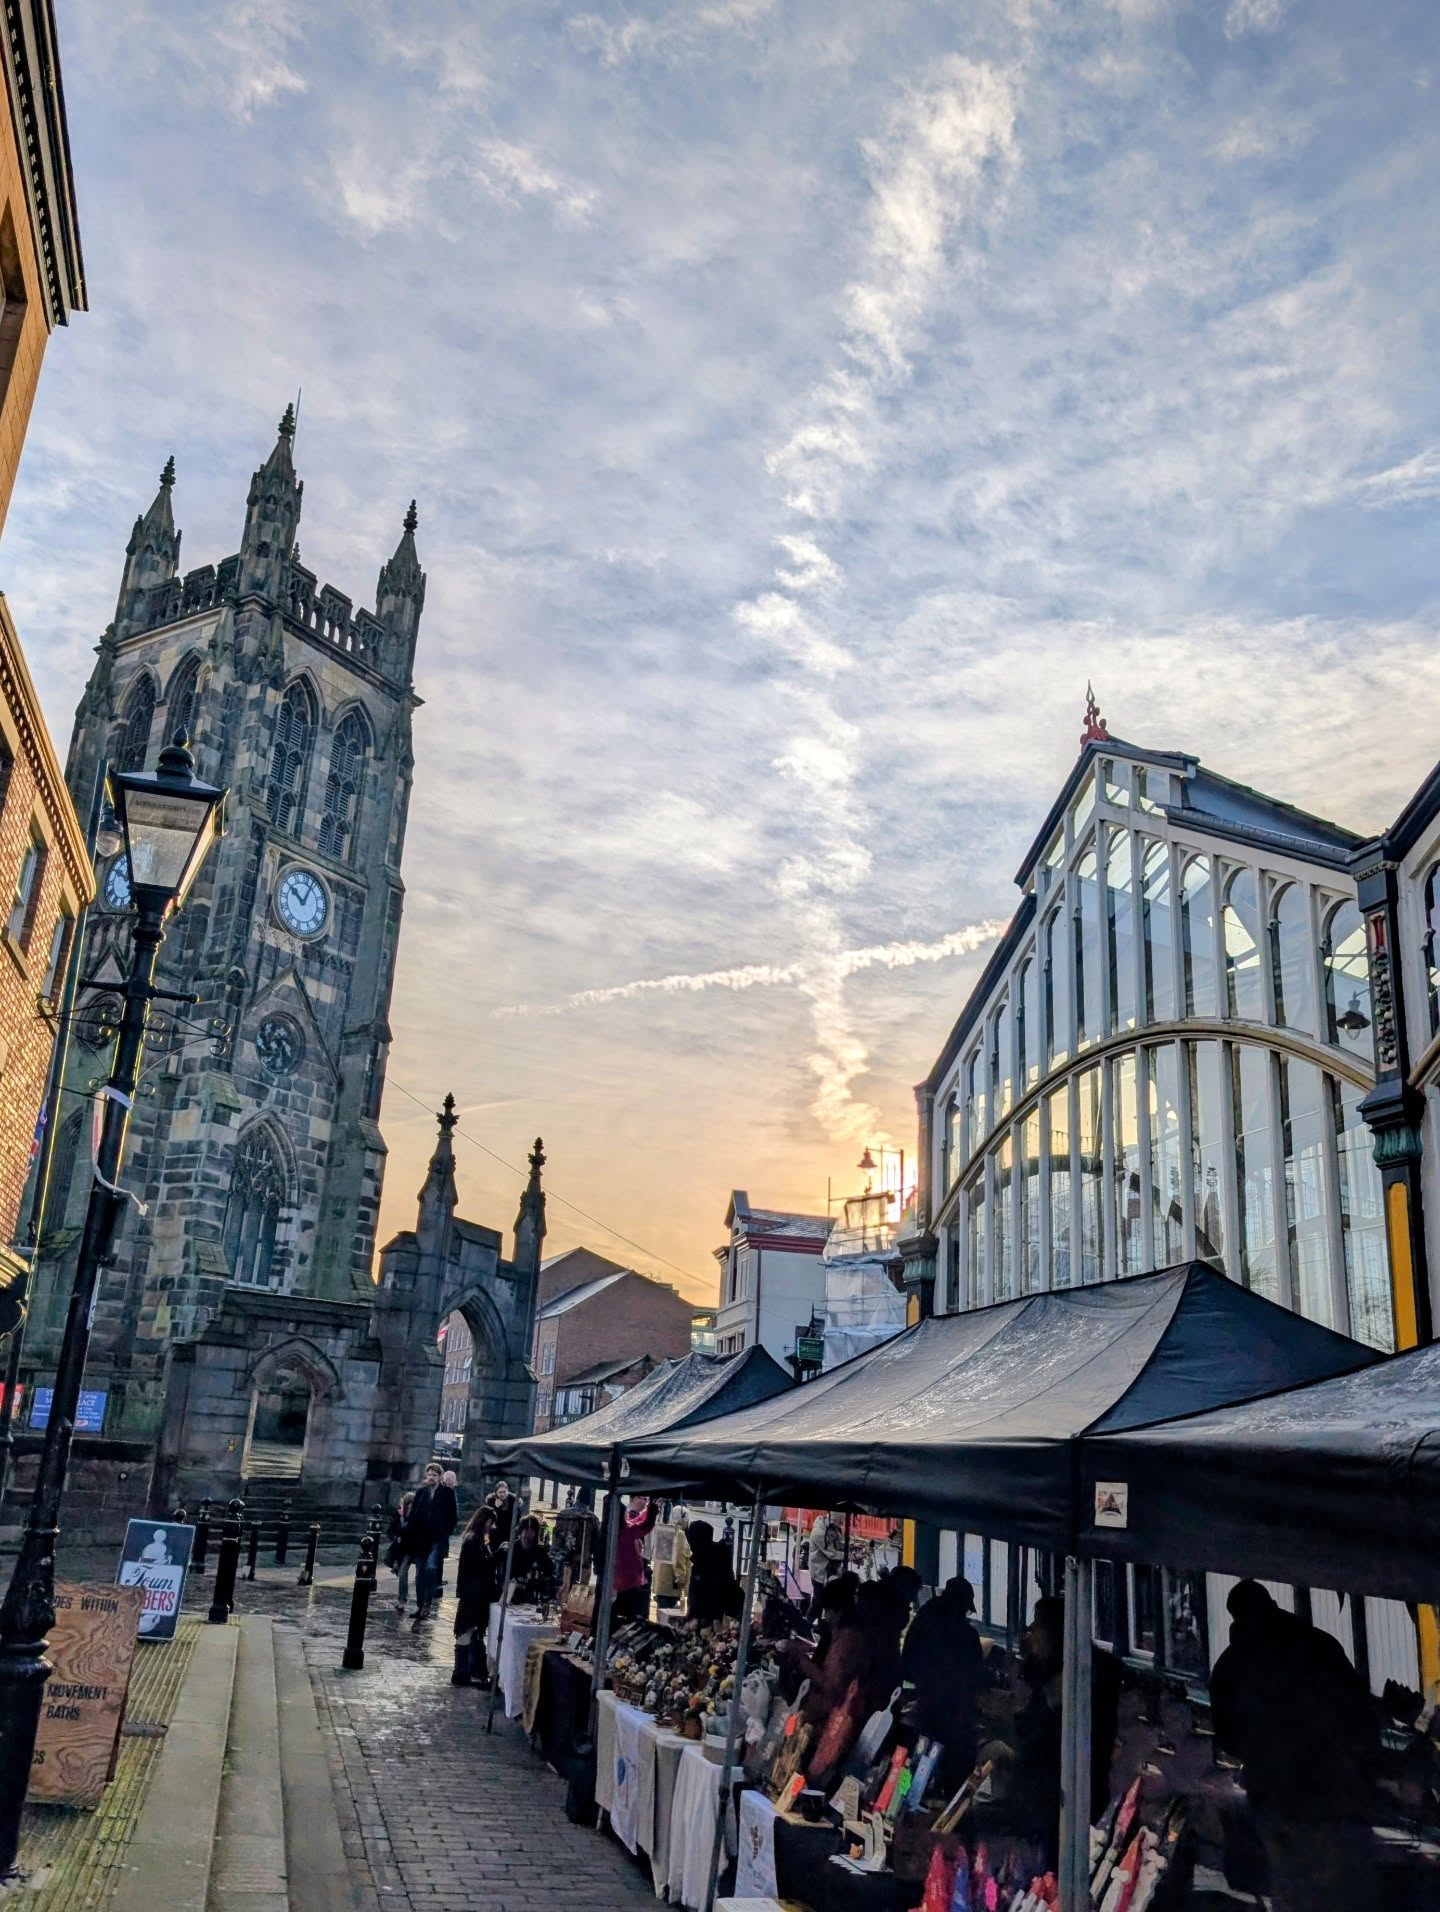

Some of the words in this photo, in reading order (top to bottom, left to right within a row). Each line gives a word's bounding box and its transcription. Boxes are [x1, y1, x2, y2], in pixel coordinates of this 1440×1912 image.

[125, 1565, 174, 1589] Town
[81, 1596, 119, 1613] WITHIN
[142, 1590, 176, 1612] BERS
[47, 1684, 108, 1700] MOVEMENT
[46, 1705, 81, 1721] BATHS
